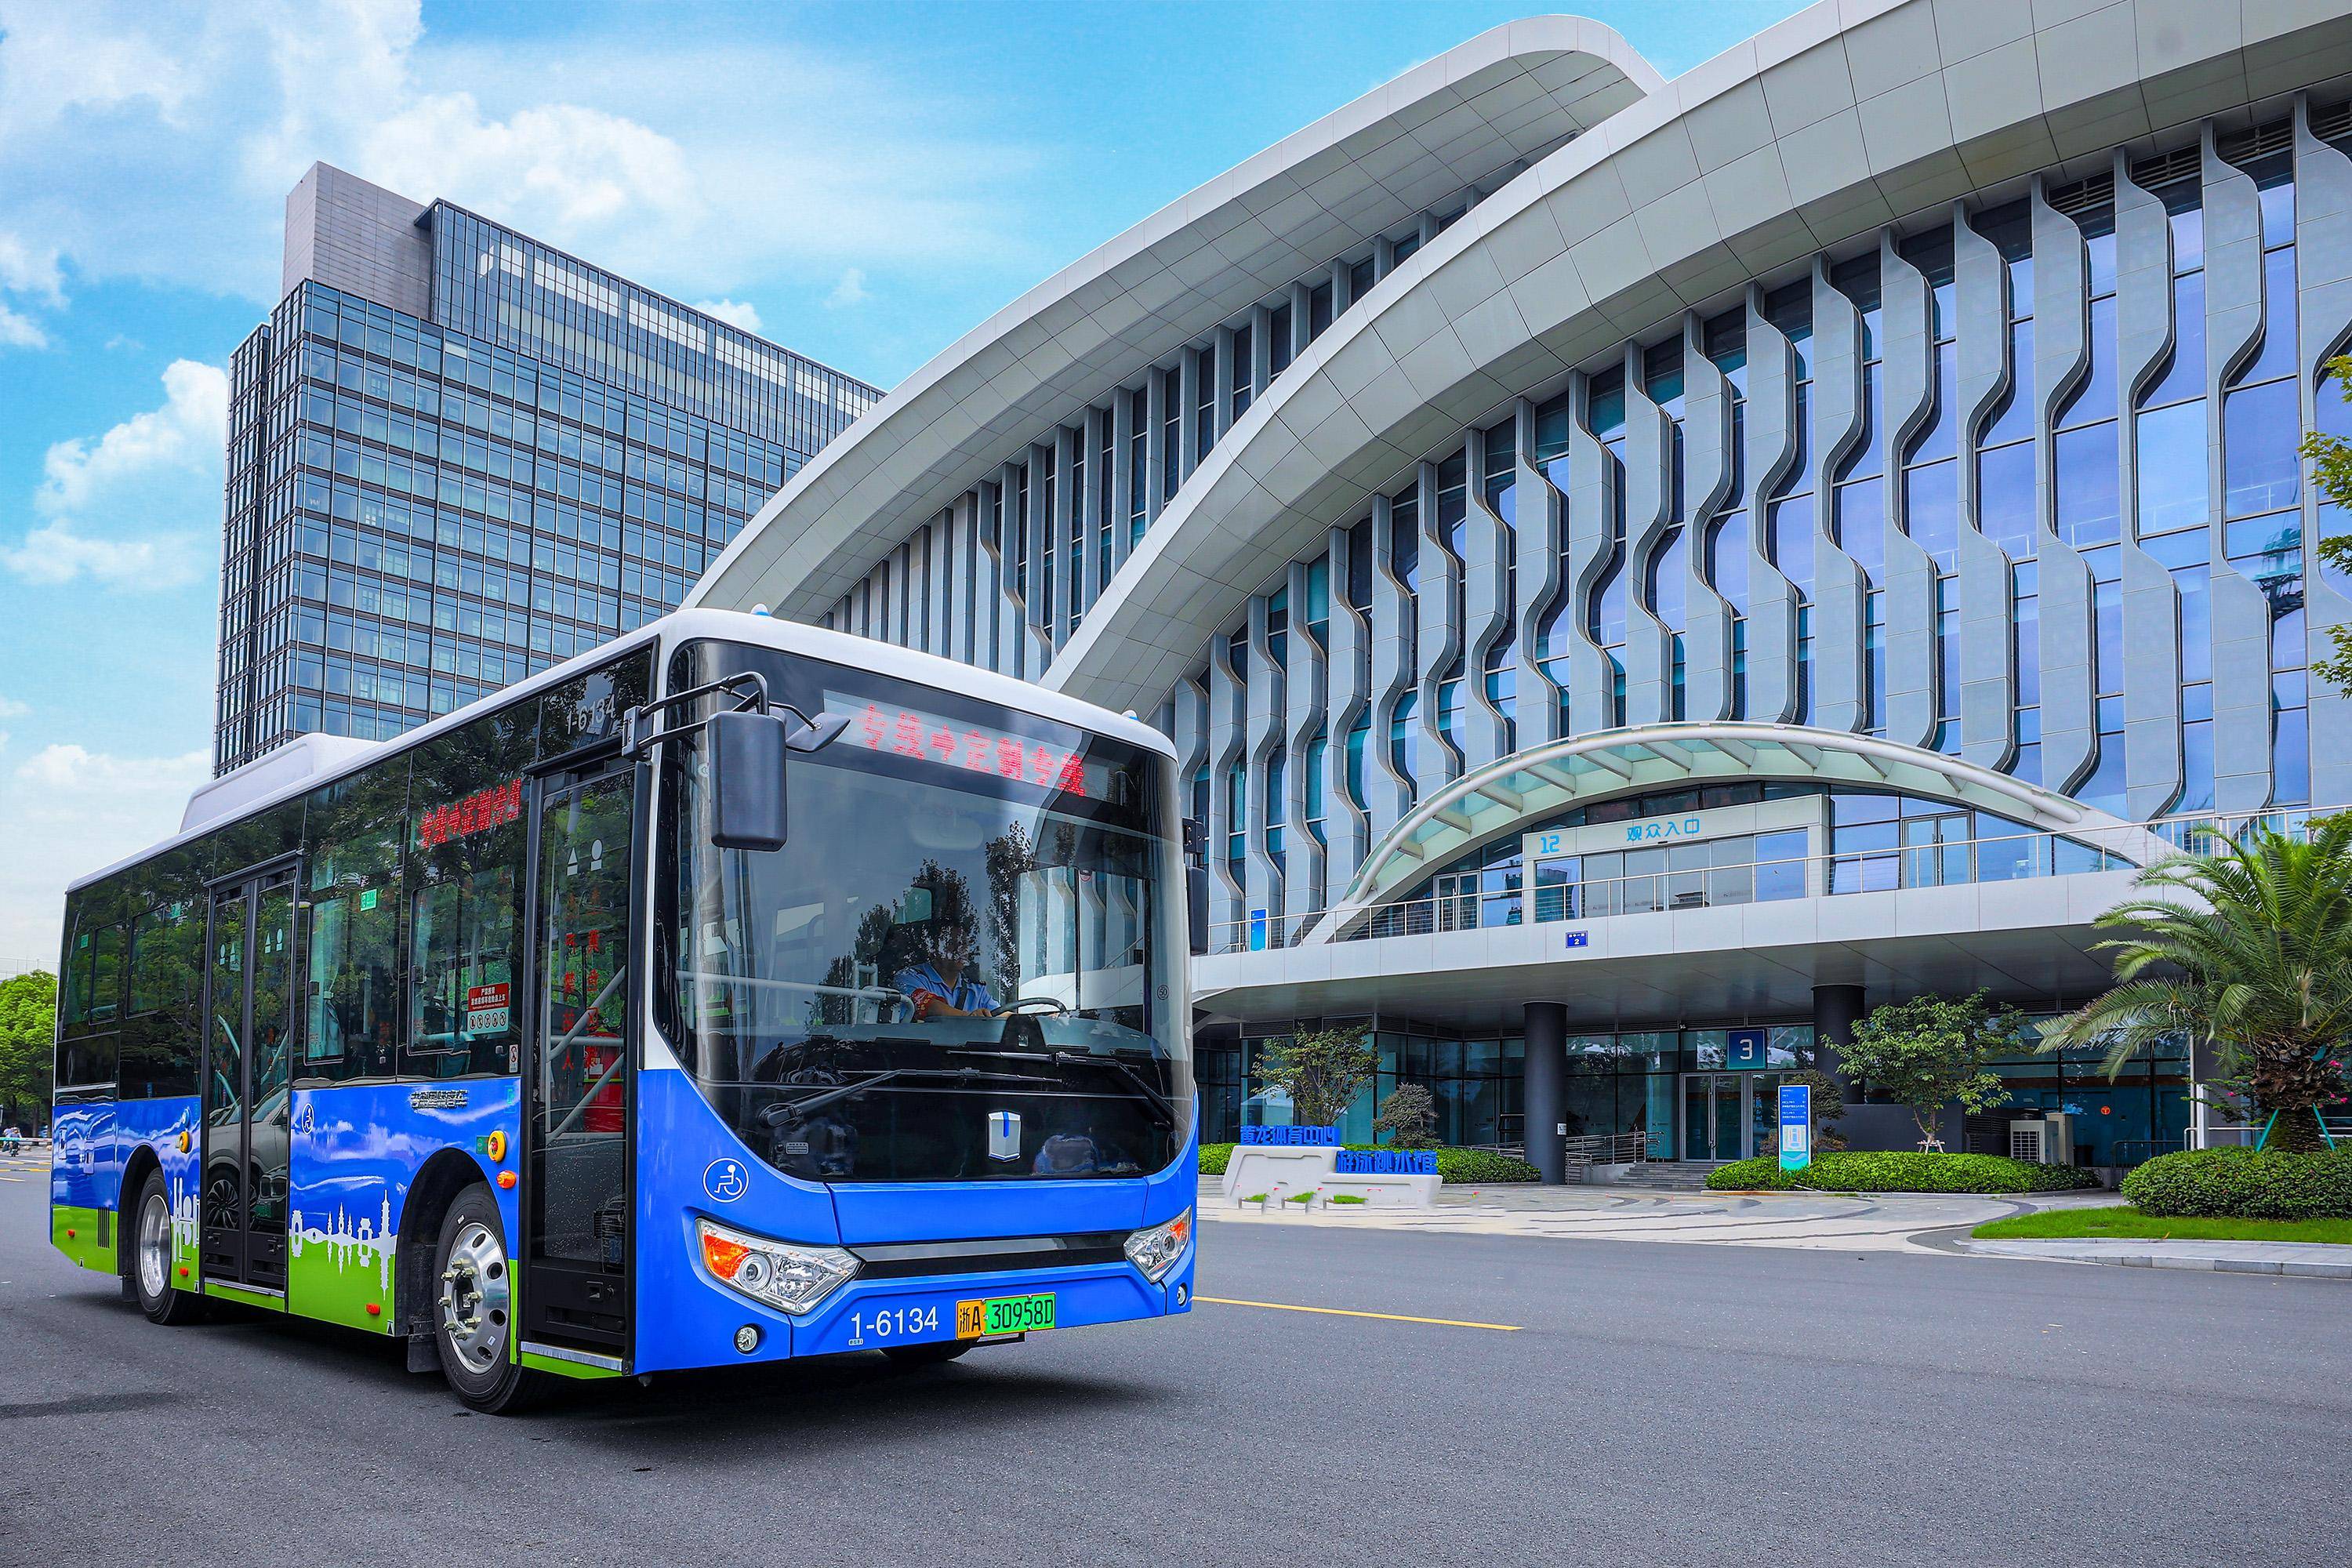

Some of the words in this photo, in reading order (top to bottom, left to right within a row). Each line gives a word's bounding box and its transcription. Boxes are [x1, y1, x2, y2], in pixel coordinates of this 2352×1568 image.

[566, 694, 615, 735] 1-6134
[859, 703, 925, 760] 专线
[963, 730, 1086, 797] 定制专线
[1541, 834, 1560, 854] 12
[1627, 818, 1700, 842] 观众入口
[1740, 1039, 1753, 1060] 3
[1240, 1125, 1340, 1145] 黄龙体育中心
[1336, 1151, 1438, 1174] 游泳跳水馆
[851, 1306, 938, 1338] 1-6134
[959, 1306, 981, 1333] 浙A
[991, 1299, 1054, 1330] 30958D
